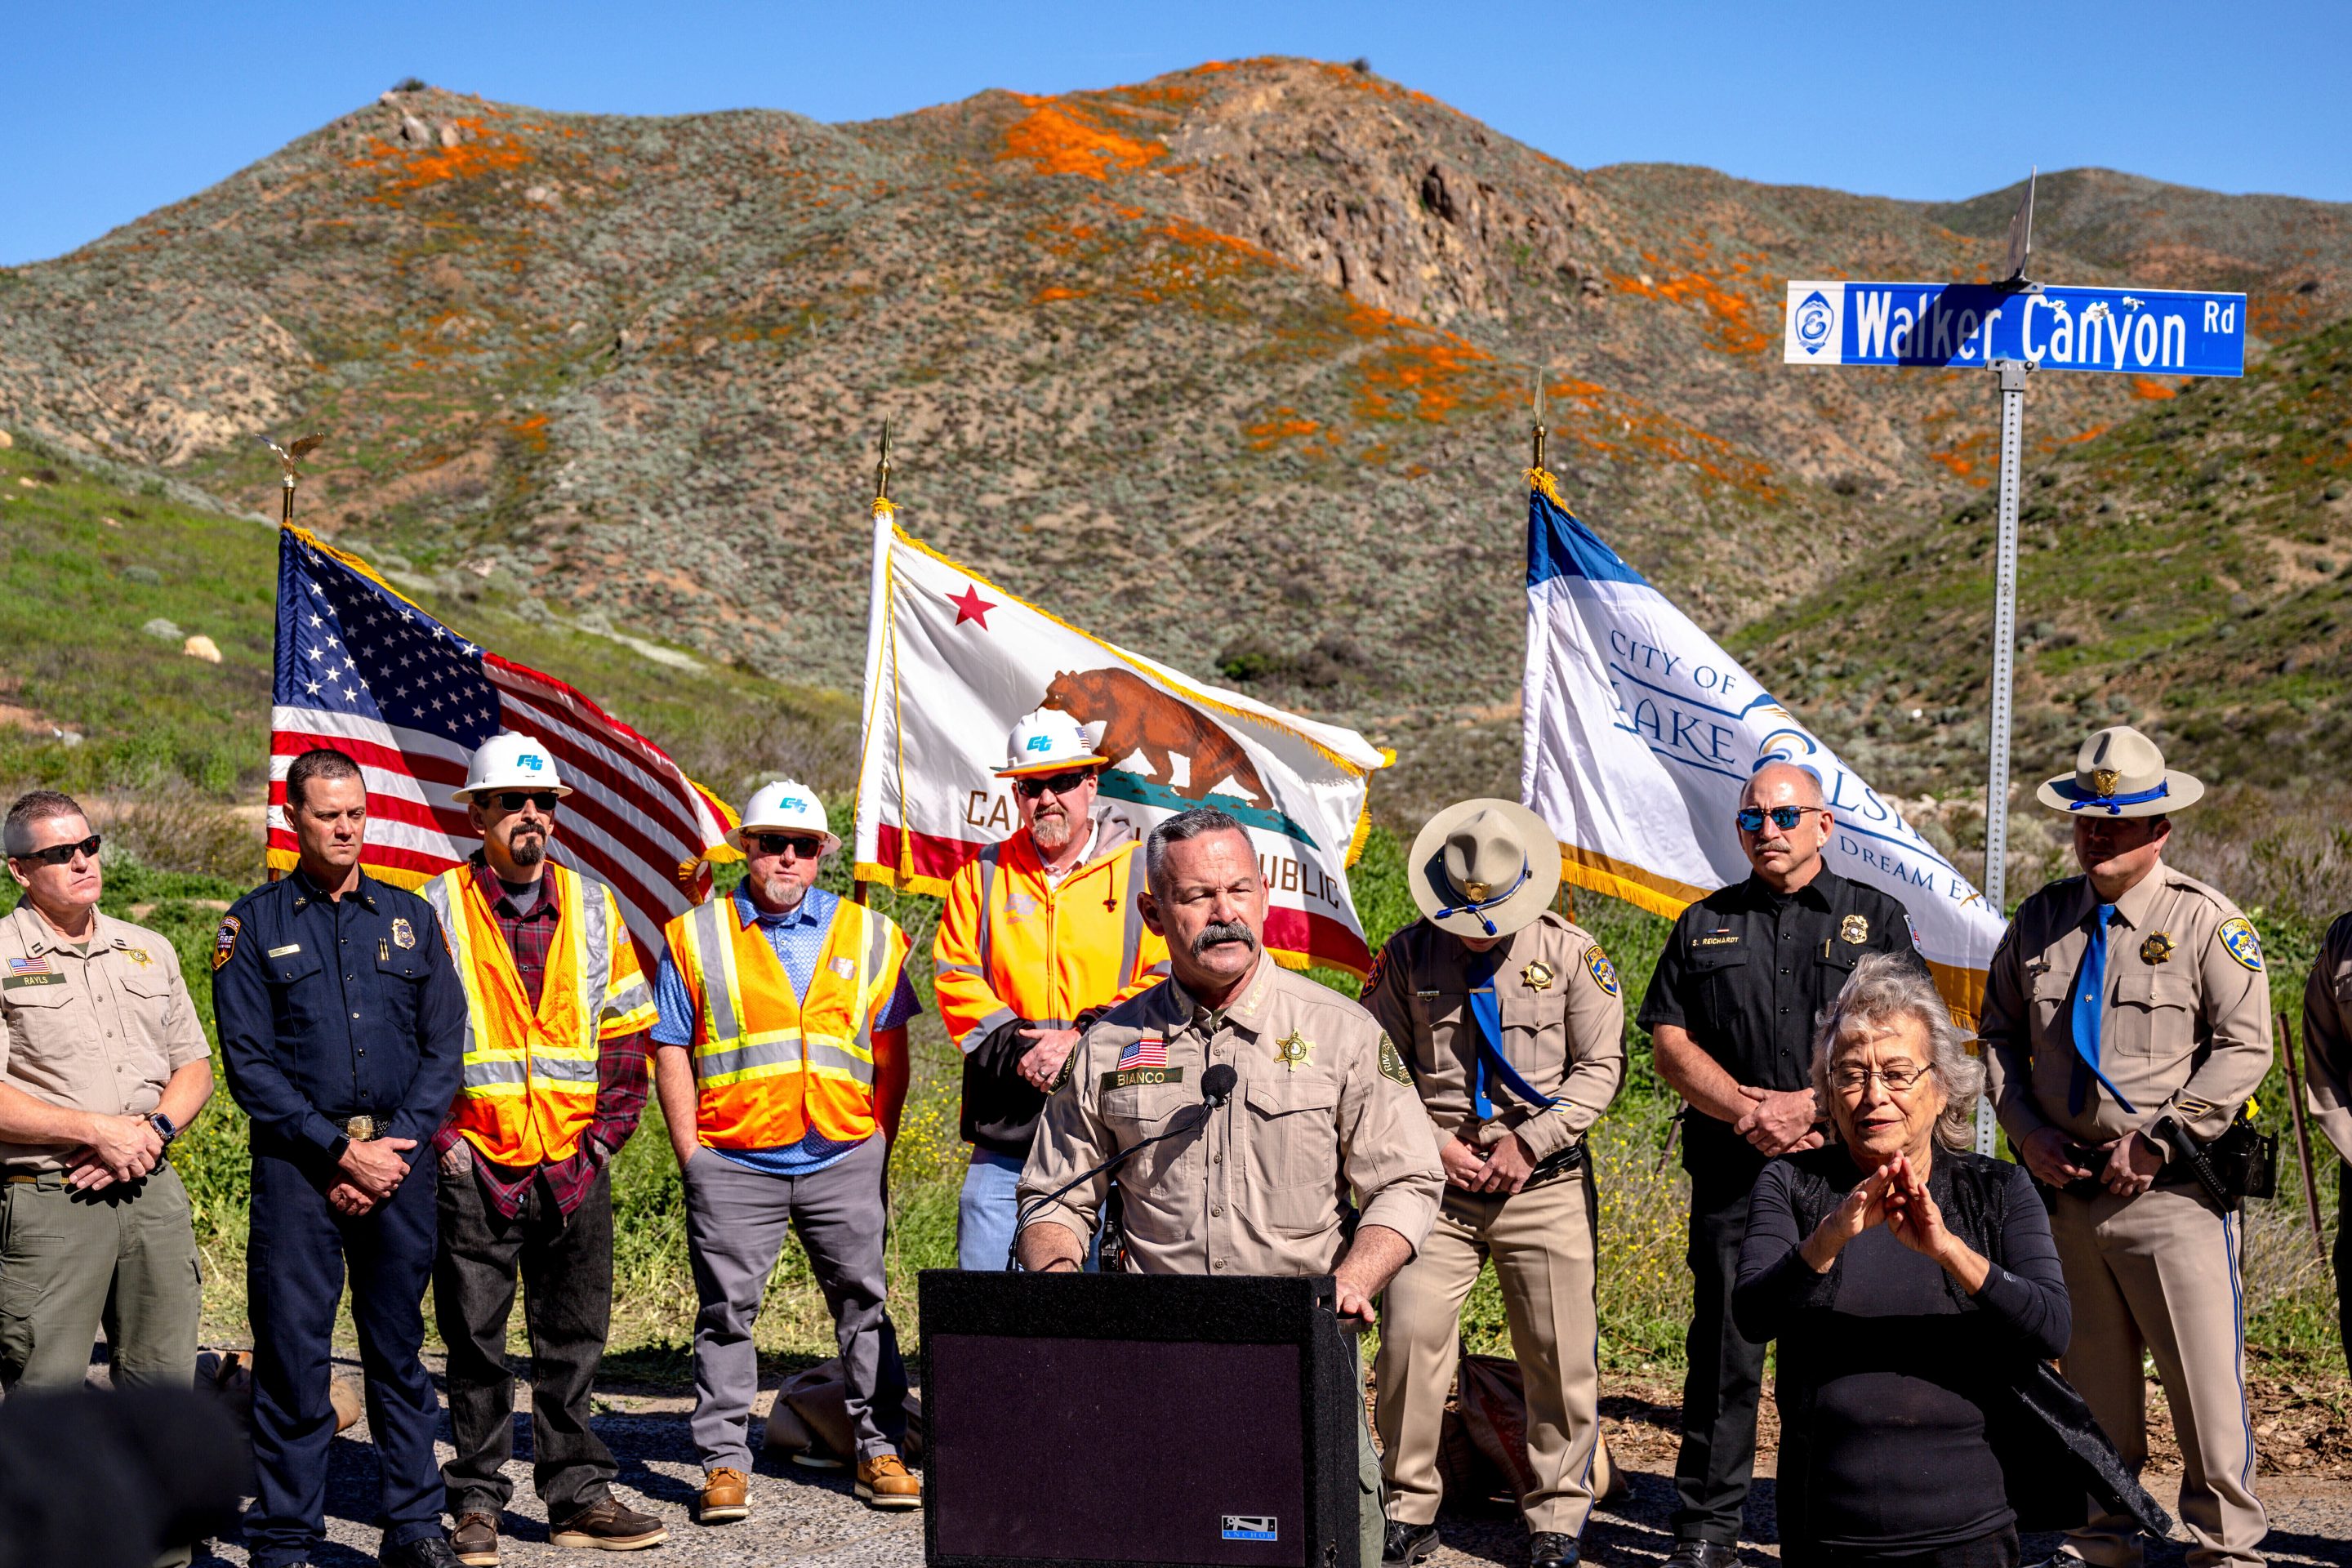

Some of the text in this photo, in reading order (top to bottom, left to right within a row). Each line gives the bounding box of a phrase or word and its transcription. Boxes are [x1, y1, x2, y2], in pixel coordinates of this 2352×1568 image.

[1856, 291, 2235, 370] Walker Canyon Rd
[1610, 630, 1736, 694] CITY OF
[1839, 835, 1934, 892] DREAM
[1702, 936, 1740, 945] REICHARDT
[24, 976, 48, 986] RAYLS
[1117, 1071, 1165, 1087] BIANCO
[1225, 1530, 1273, 1539] ANCHOR
